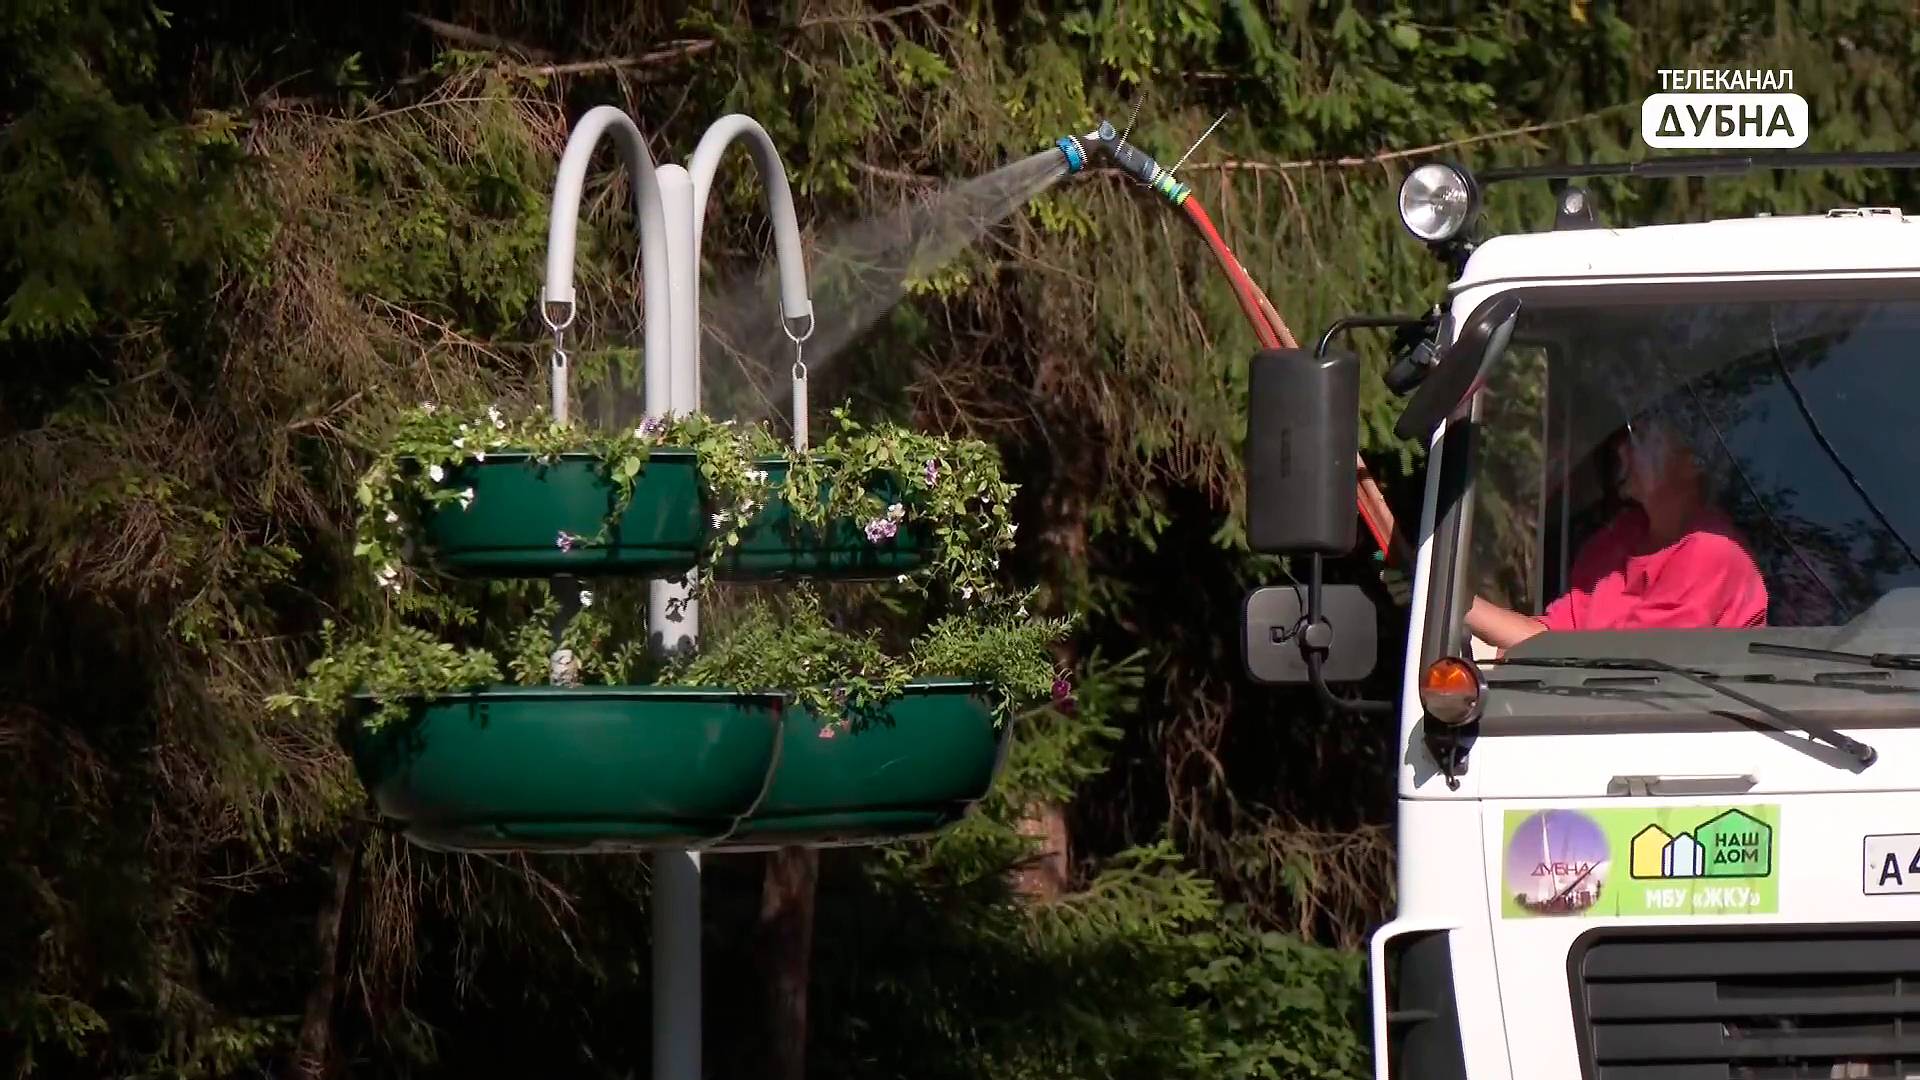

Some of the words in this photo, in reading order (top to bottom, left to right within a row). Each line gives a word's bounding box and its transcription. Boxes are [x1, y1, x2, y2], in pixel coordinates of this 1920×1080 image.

[1715, 832, 1760, 848] НАШ
[1713, 849, 1759, 865] ДОМ
[1530, 862, 1592, 877] ДУБНА
[1645, 888, 1687, 909] МБУ
[1692, 887, 1760, 909] «ЖКУ»
